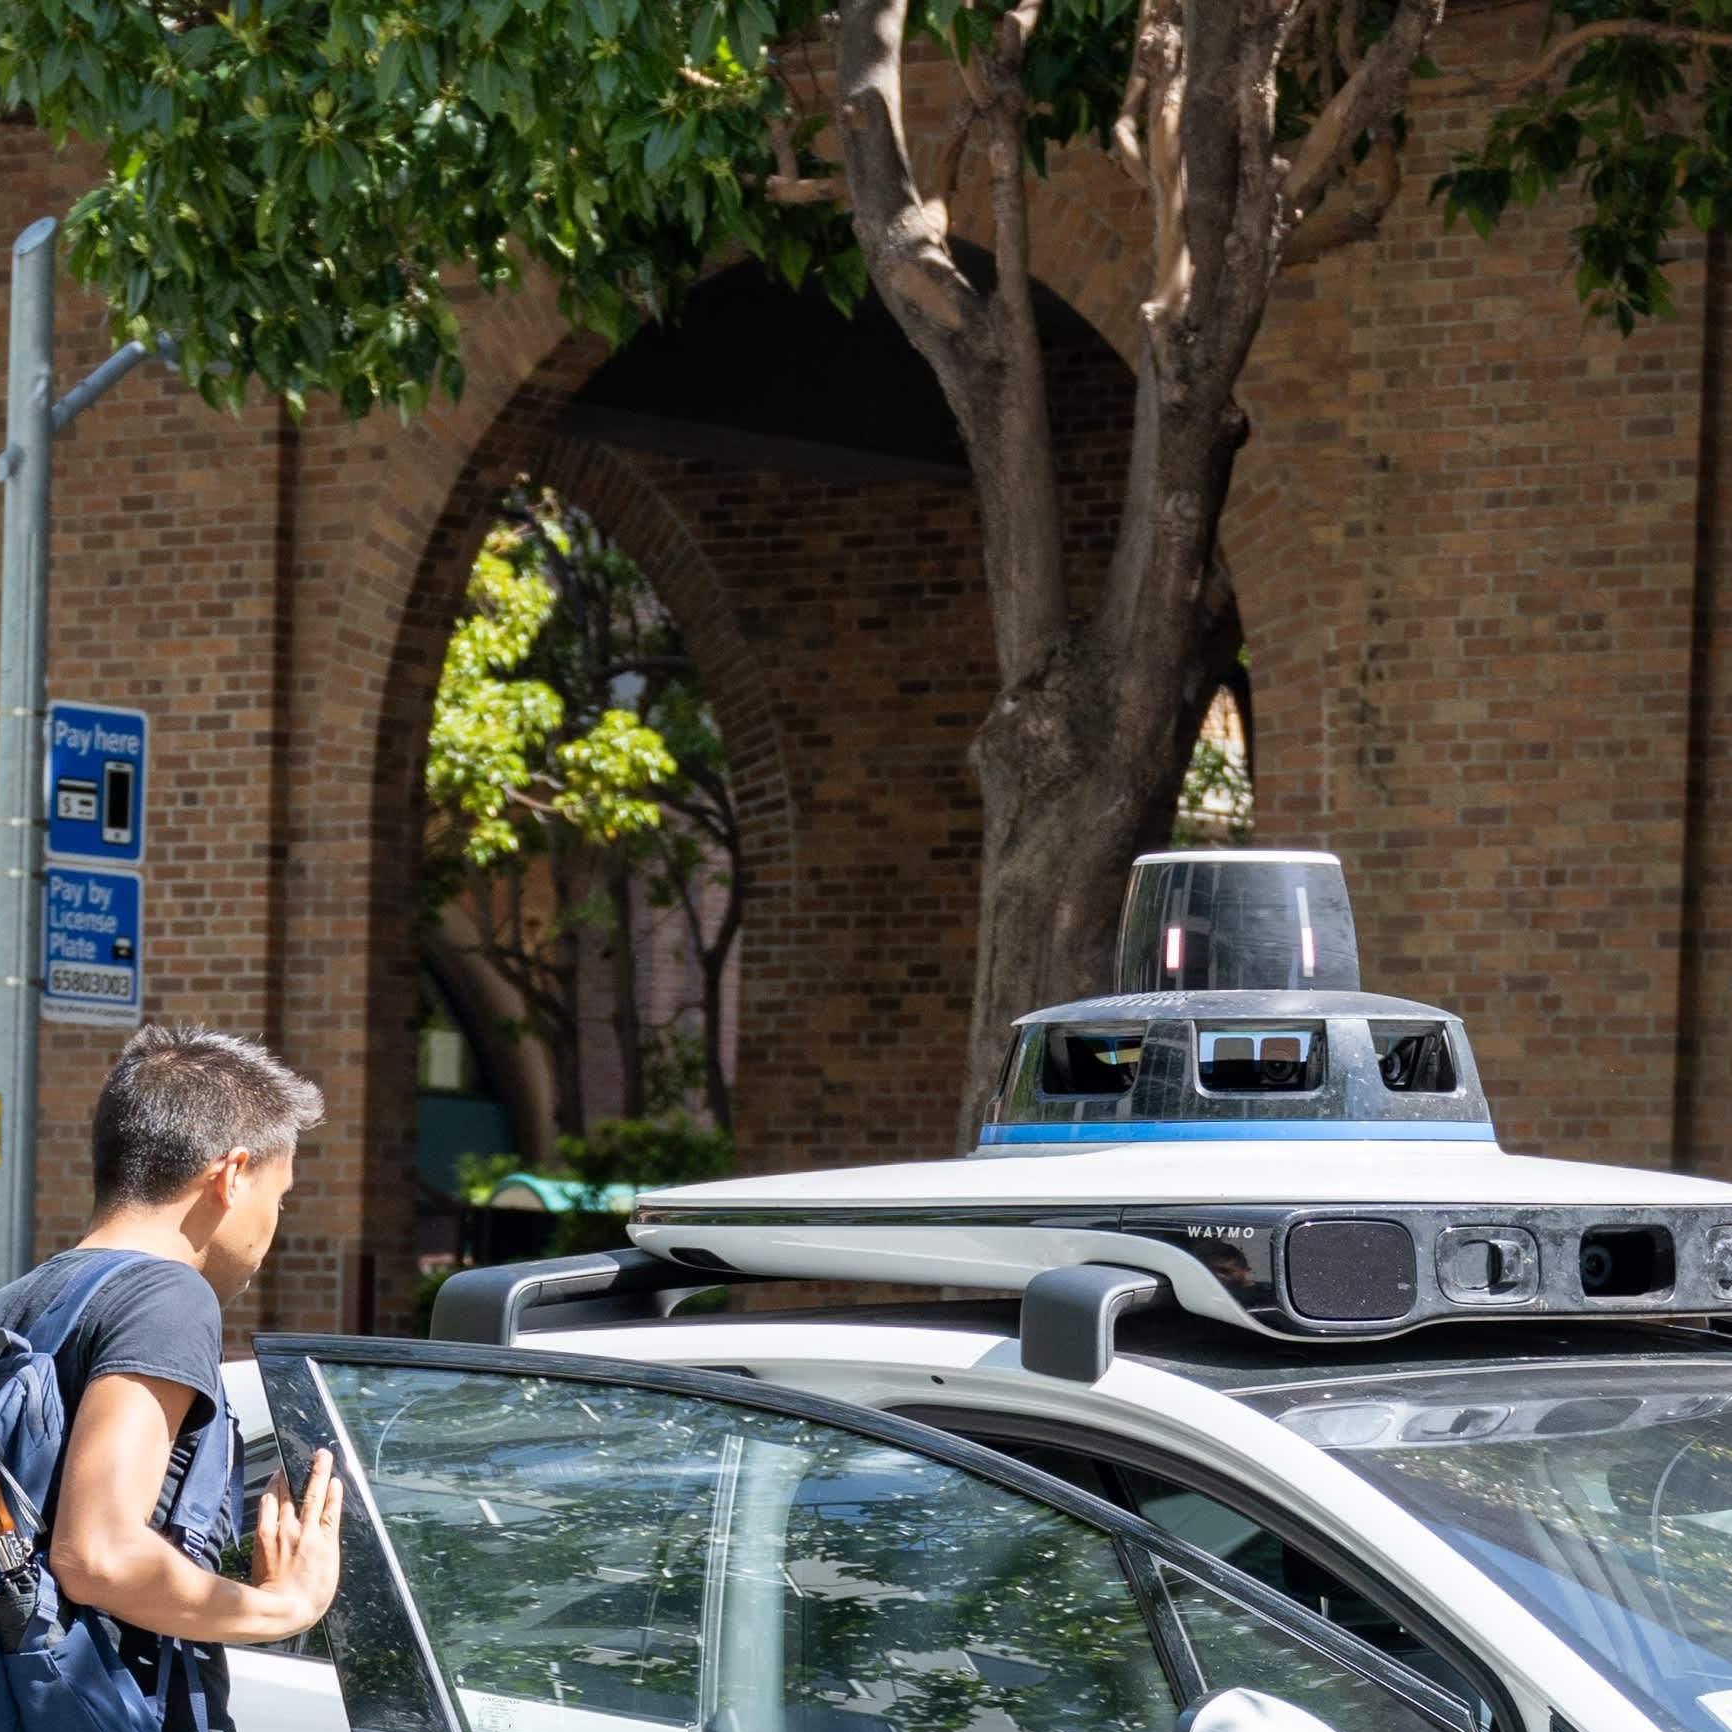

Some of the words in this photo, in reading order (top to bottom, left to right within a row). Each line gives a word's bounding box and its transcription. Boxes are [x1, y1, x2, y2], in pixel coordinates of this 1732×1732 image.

[54, 720, 93, 757] Pay
[93, 723, 140, 756] here
[50, 876, 85, 909] Pay
[87, 879, 113, 911] by
[49, 904, 117, 934] License
[49, 932, 97, 960] Plate
[1187, 1224, 1256, 1240] WAYMO
